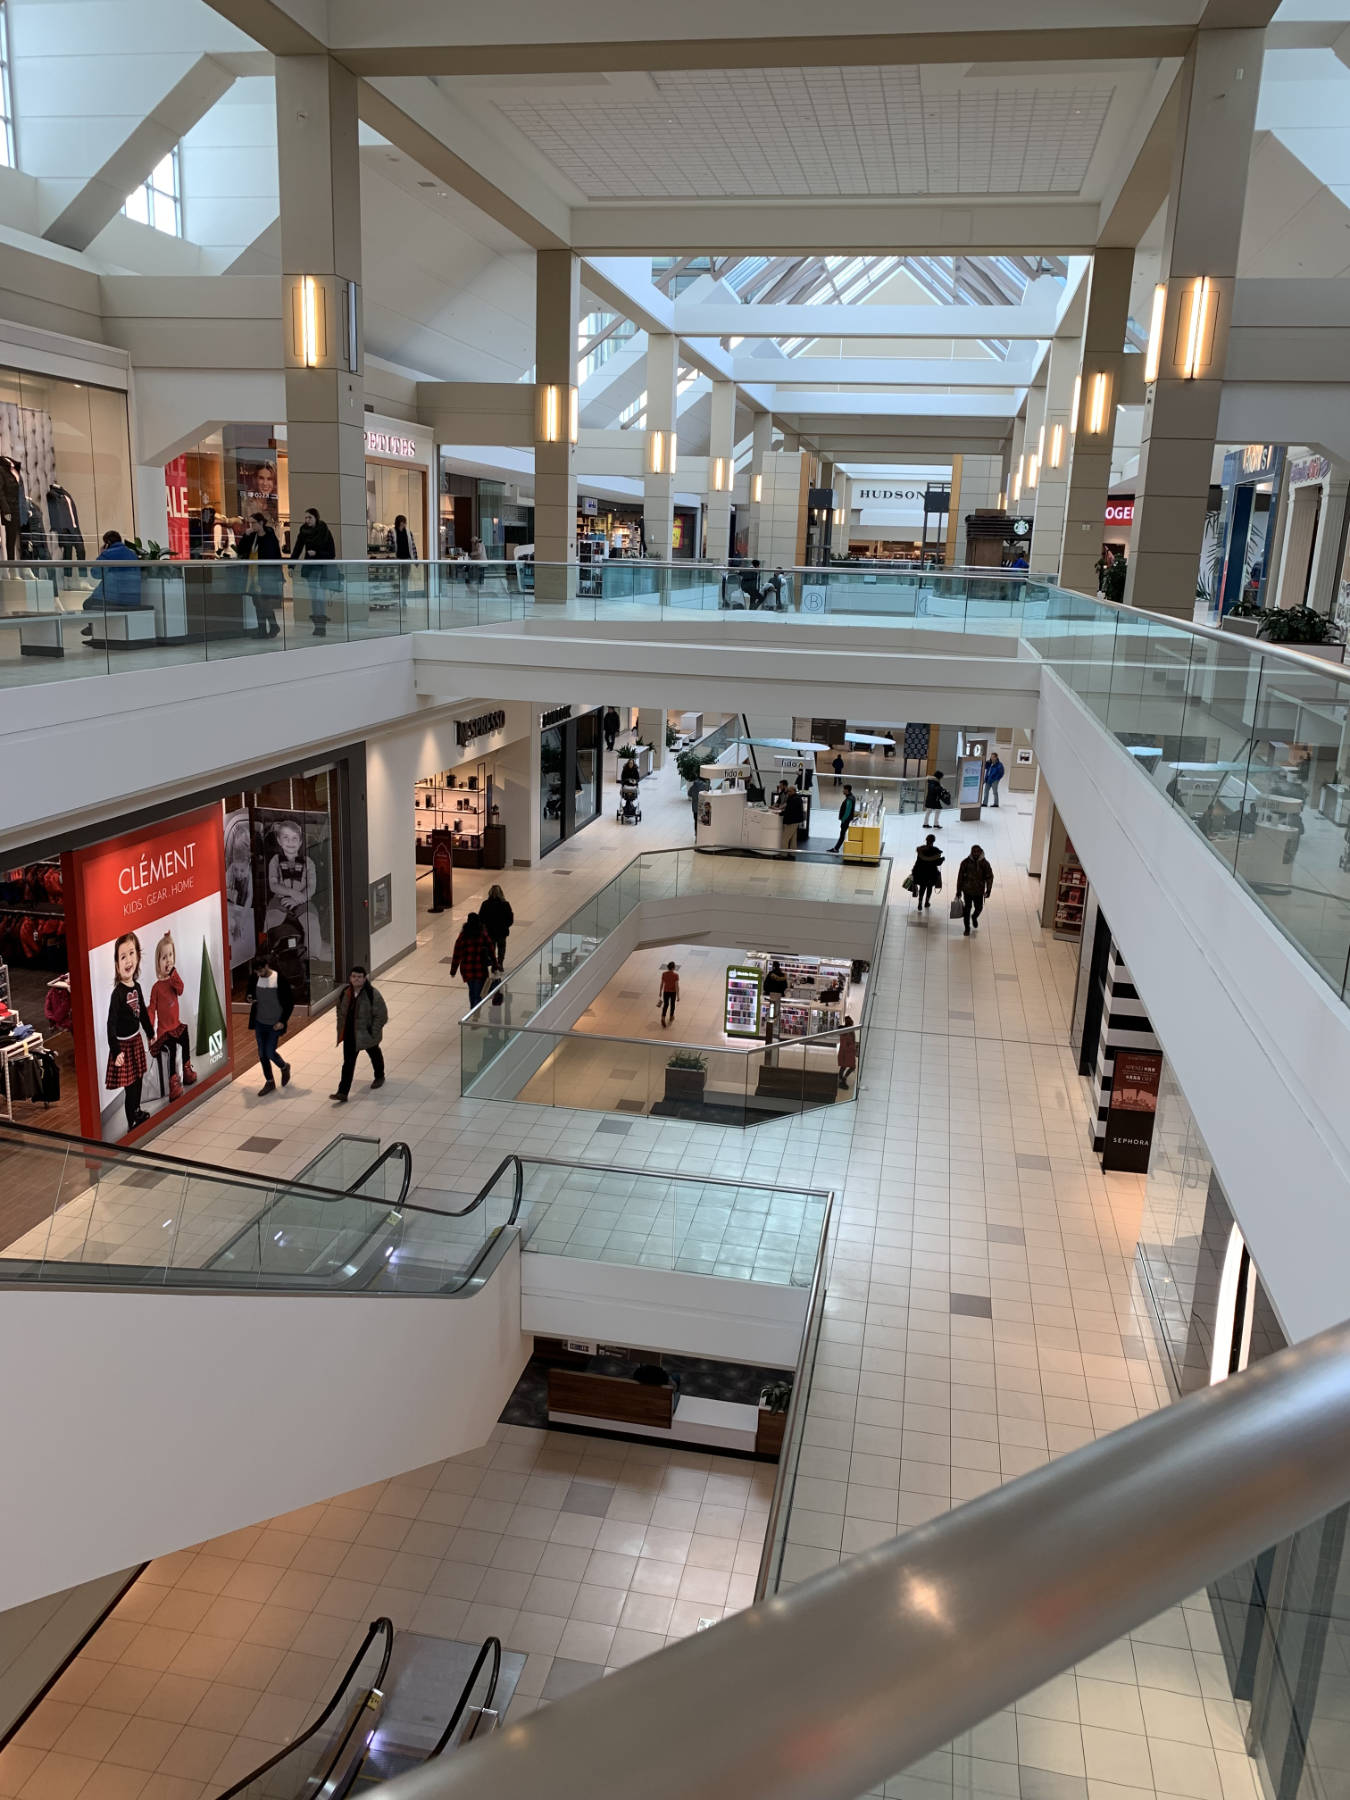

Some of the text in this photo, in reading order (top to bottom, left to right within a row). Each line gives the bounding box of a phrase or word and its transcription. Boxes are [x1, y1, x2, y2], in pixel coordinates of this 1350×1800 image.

[1105, 506, 1134, 520] OGE
[781, 760, 797, 768] fido
[724, 768, 738, 779] fido
[118, 842, 196, 895] CLÉMENT
[1112, 1136, 1149, 1146] SEPHORA
